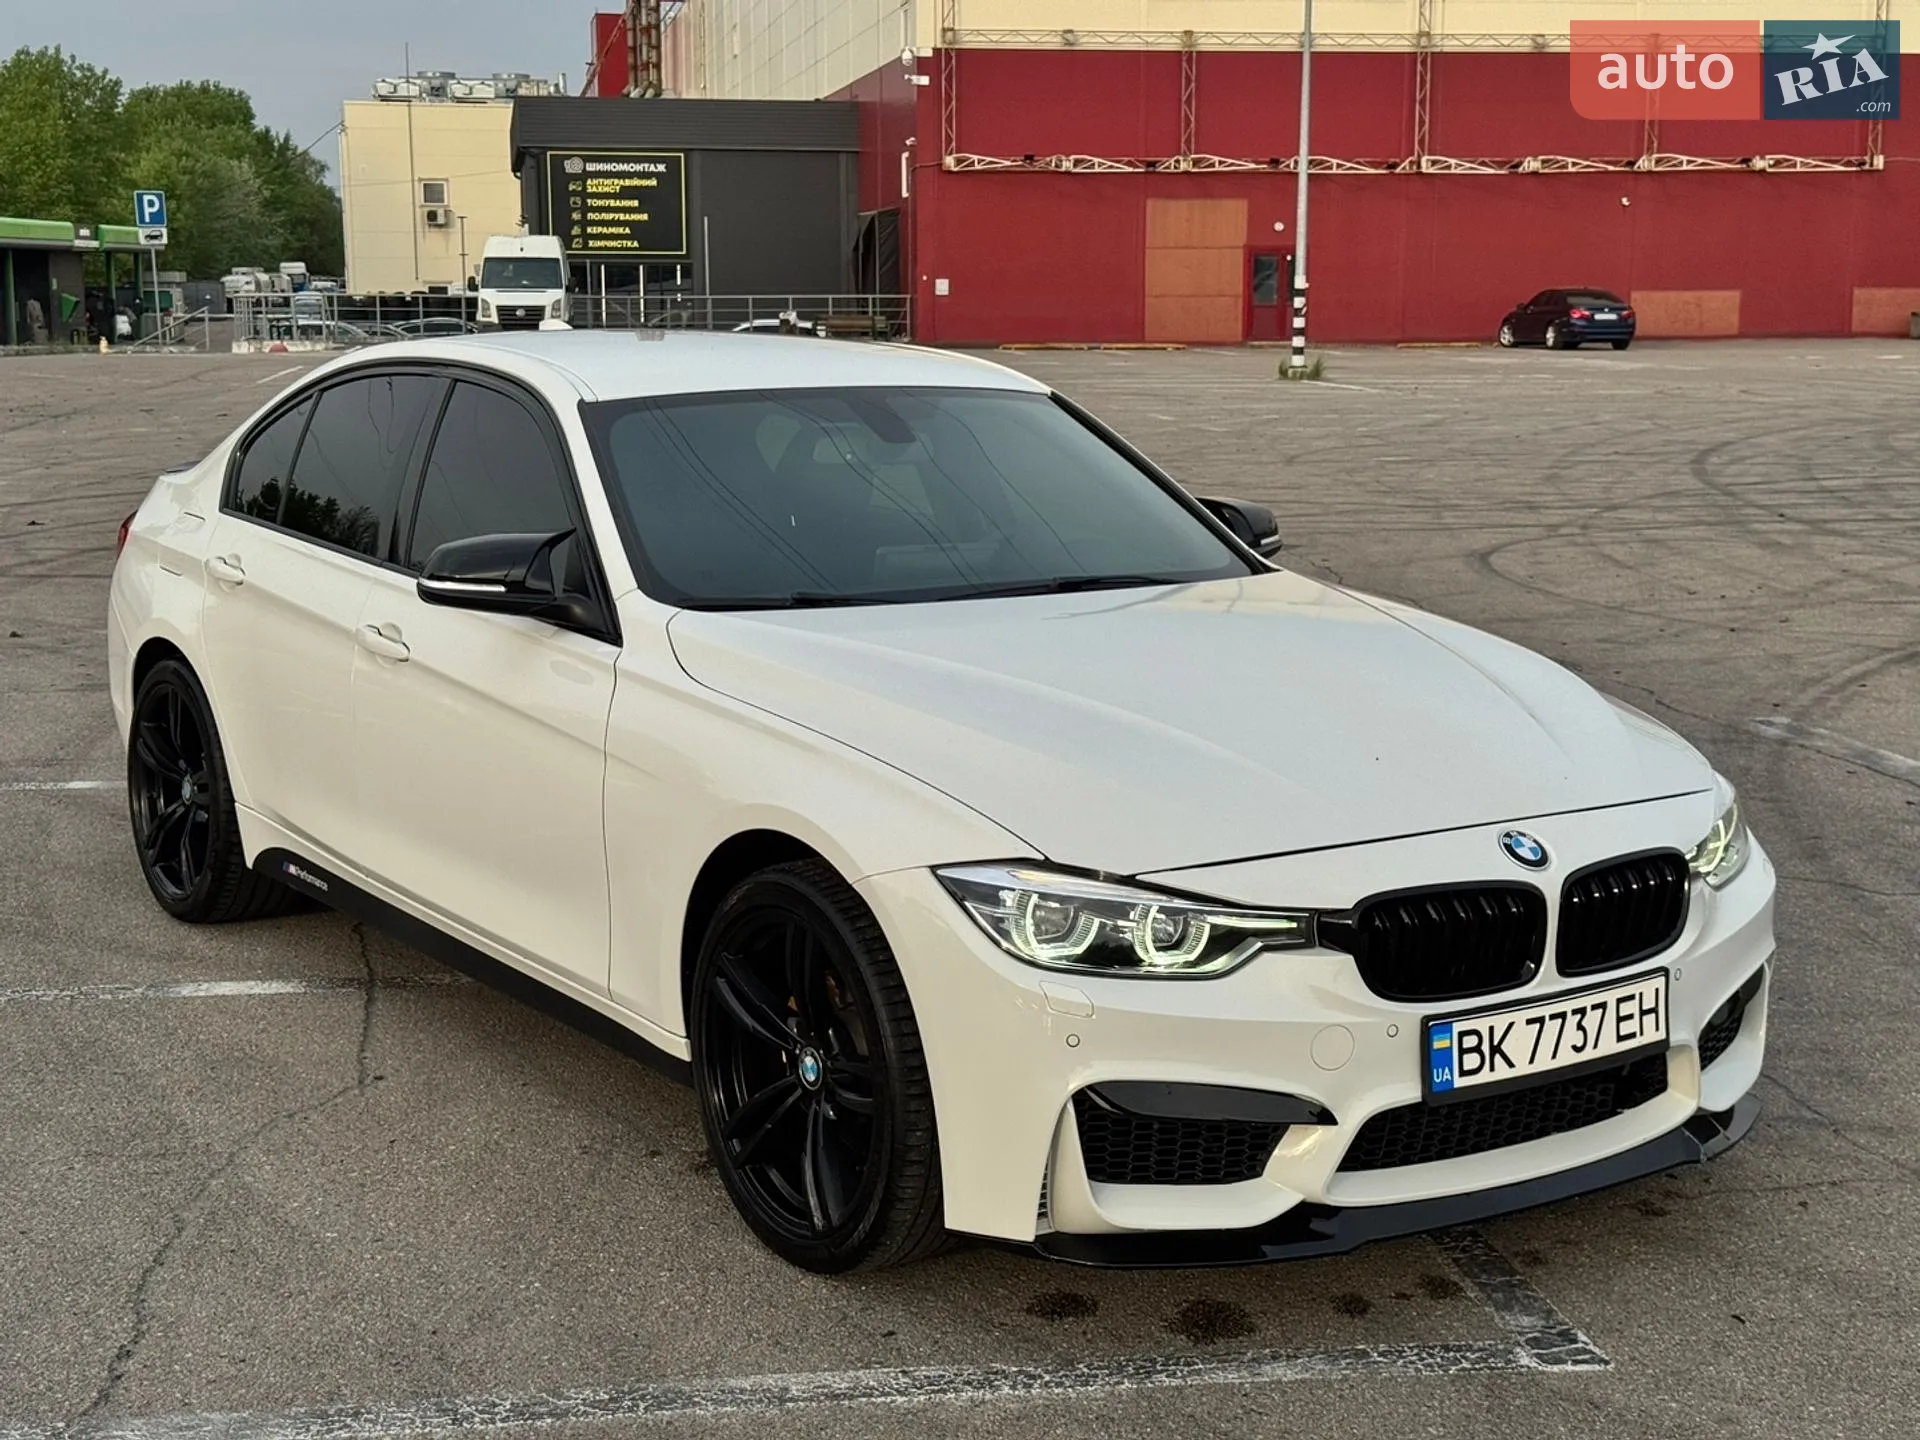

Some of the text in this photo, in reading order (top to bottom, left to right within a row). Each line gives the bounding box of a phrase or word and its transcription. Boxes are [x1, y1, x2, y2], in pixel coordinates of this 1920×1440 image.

[585, 162, 667, 172] ШИНОМОНТАЖ
[586, 185, 620, 193] ЗАХИСТ
[586, 199, 639, 207] ТОНУВАННЯ
[143, 194, 160, 223] P
[586, 212, 649, 221] ПОЛІРУВАННЯ
[586, 226, 631, 234] КЕРАМІКА
[587, 240, 640, 248] ХІМЧИСТКА
[1457, 987, 1660, 1078] BK 7737 EH
[1433, 1066, 1452, 1083] UA
